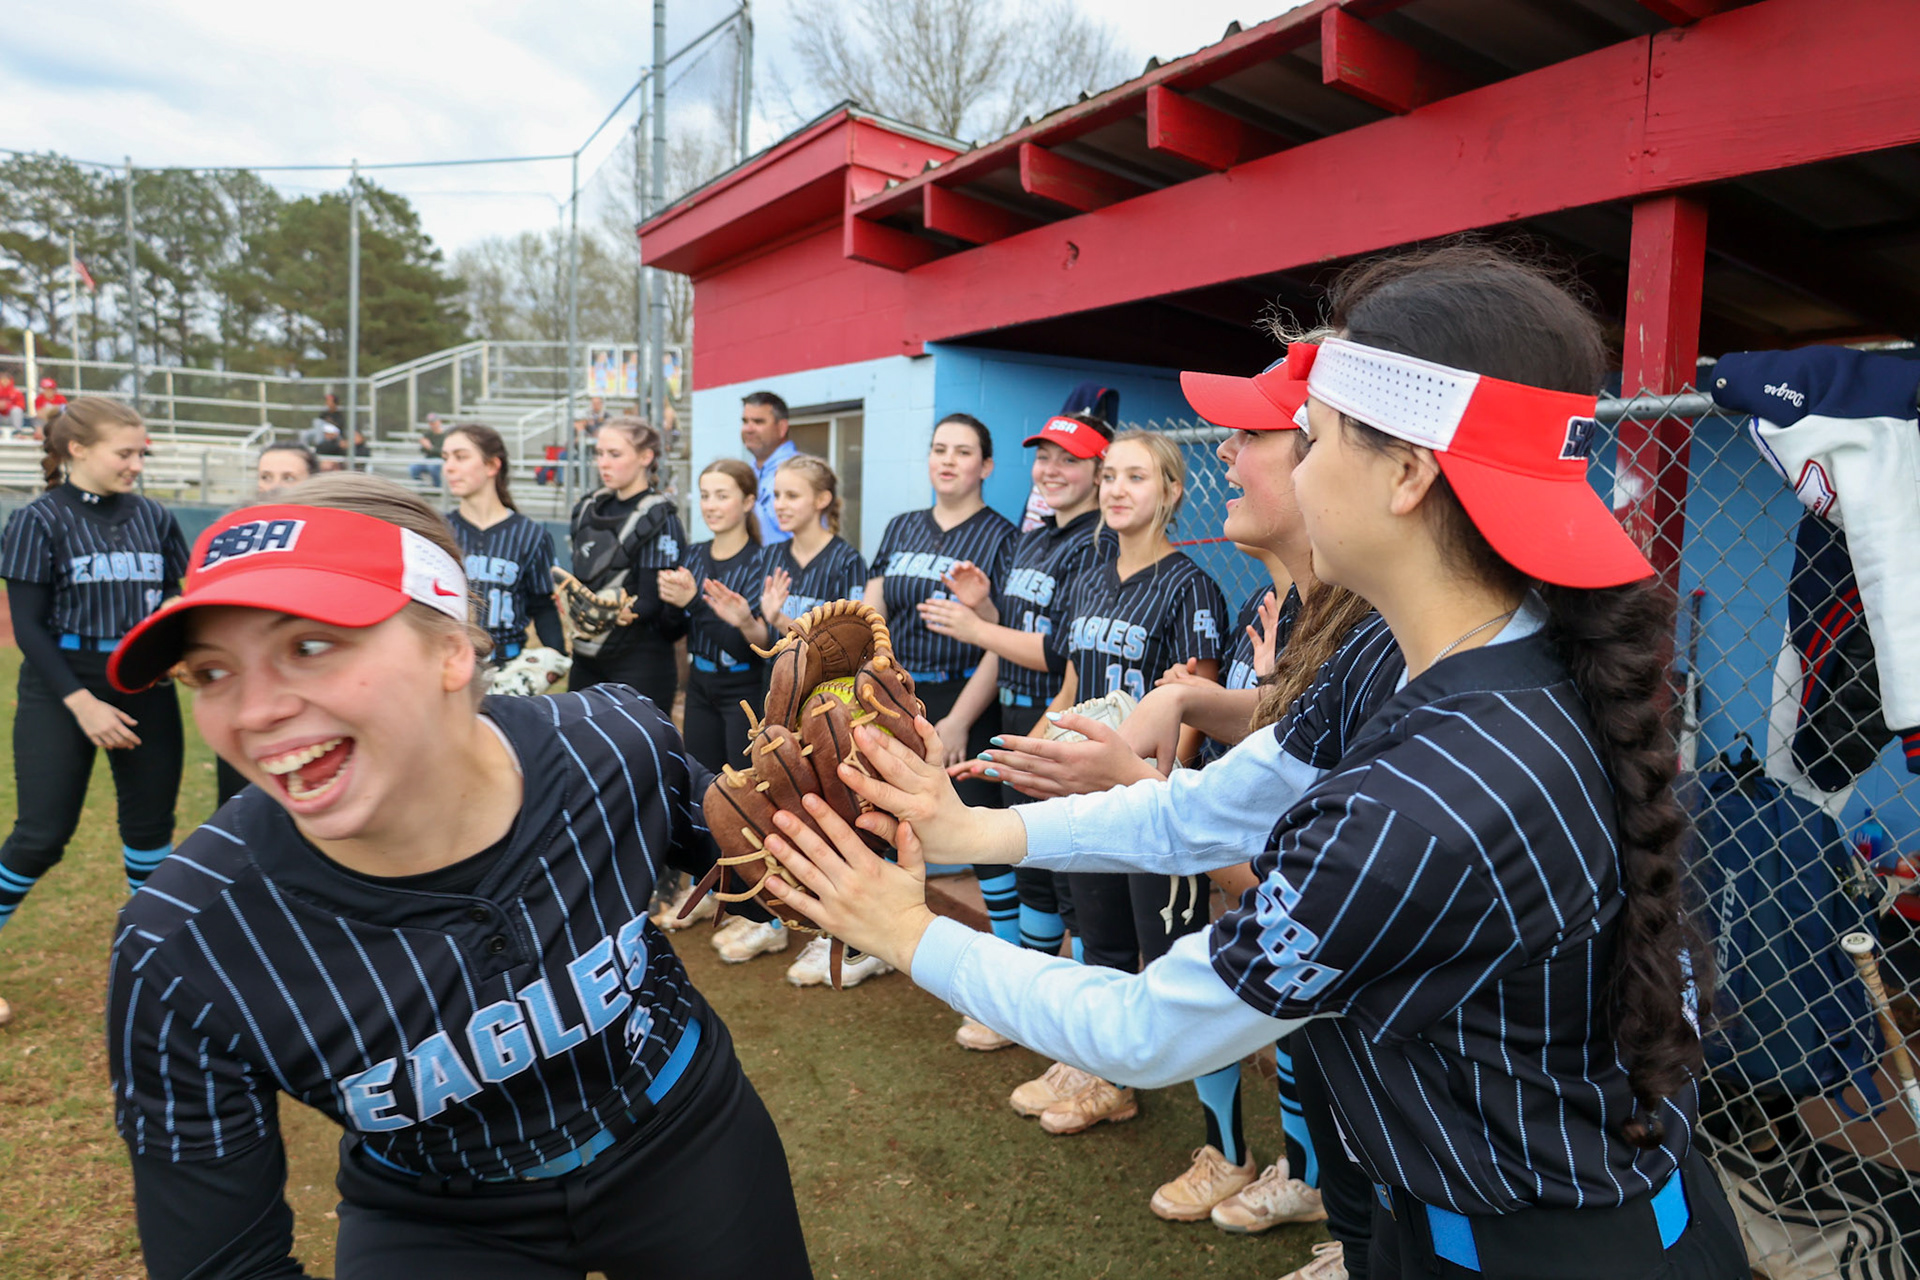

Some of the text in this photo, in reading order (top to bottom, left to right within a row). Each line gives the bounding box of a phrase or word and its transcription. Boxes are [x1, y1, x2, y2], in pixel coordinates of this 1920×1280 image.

[1048, 419, 1079, 434] SBA
[199, 519, 304, 571] SBA
[71, 552, 164, 584] EAGLES
[465, 554, 519, 586] GLES
[1254, 870, 1345, 1001] SBA
[338, 910, 650, 1132] EAGLES
